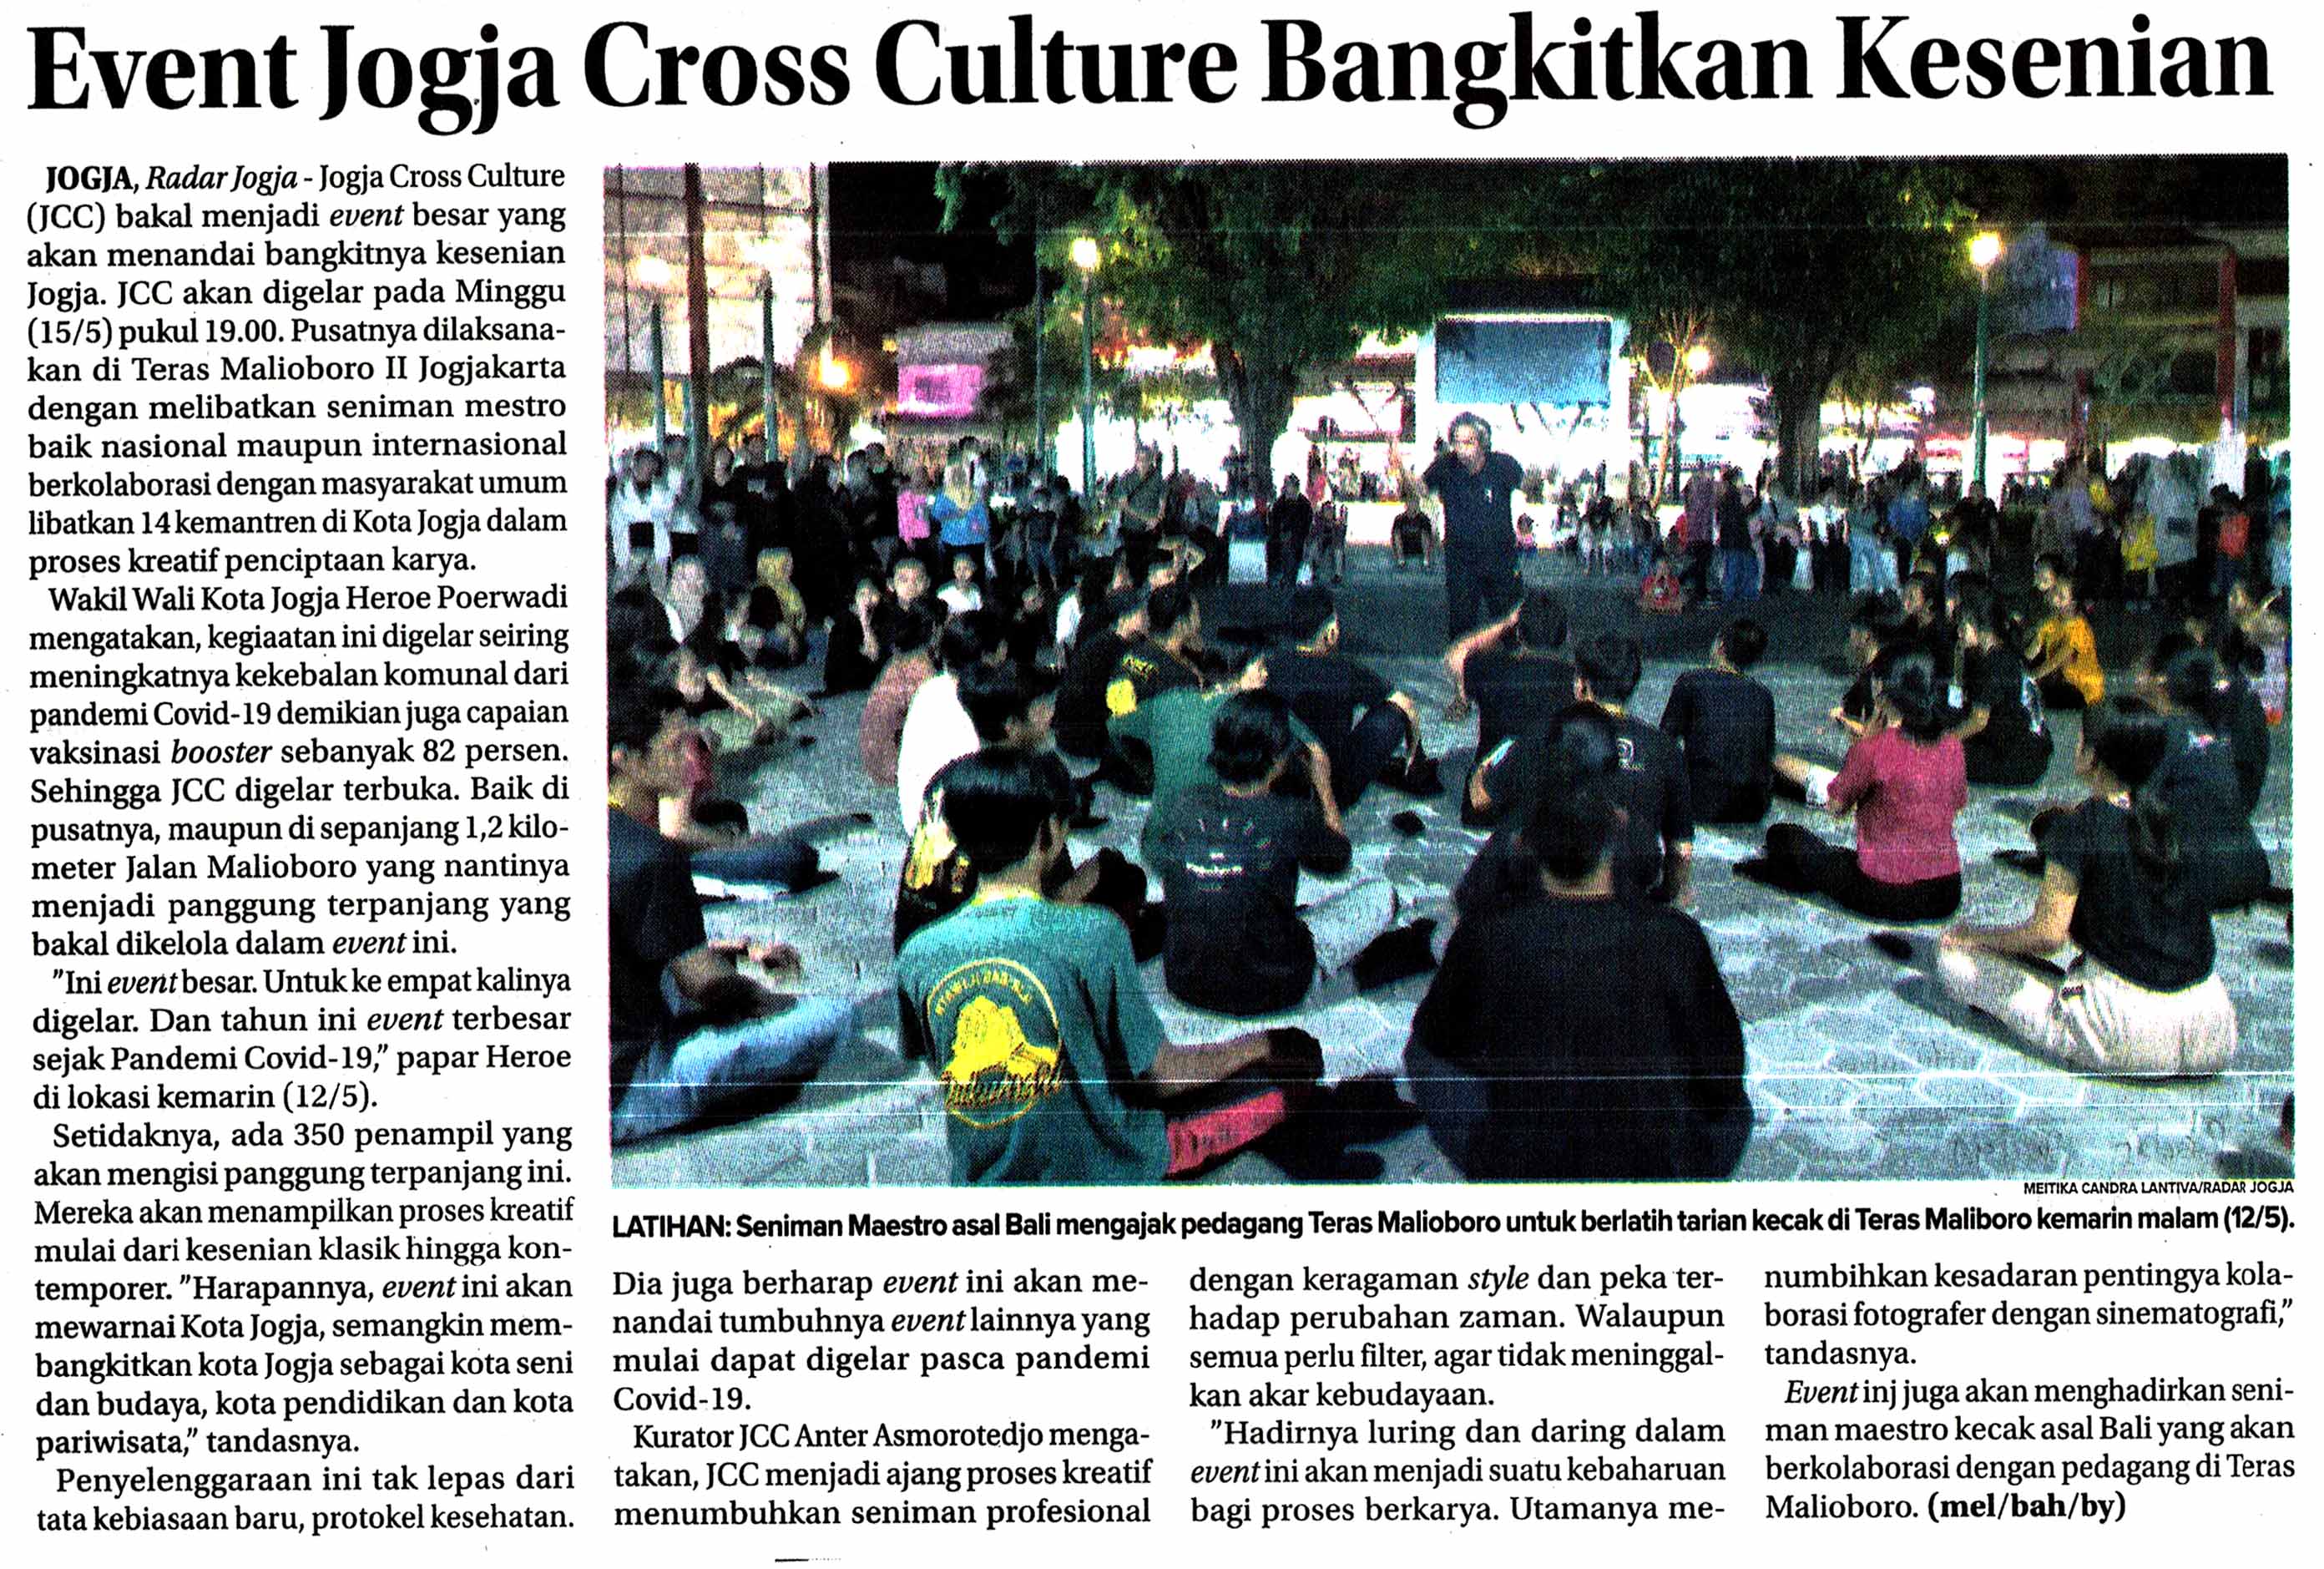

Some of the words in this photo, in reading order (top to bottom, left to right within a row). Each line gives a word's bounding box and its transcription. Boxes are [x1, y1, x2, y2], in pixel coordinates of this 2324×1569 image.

[26, 26, 300, 110] Event
[318, 23, 561, 137] Jogja
[584, 21, 851, 108] Cross
[875, 13, 1238, 106] Culture
[1260, 10, 1814, 130] Bangkitkan
[1836, 13, 2275, 100] Kesenian
[27, 201, 105, 235] (JCC)
[115, 202, 193, 229] bakal
[201, 201, 321, 235] menjadi
[329, 204, 405, 227] event
[412, 200, 490, 227] besar
[497, 207, 567, 233] yang
[27, 281, 107, 313] Jogja.
[117, 280, 173, 309] JCC
[183, 278, 253, 305] akan
[263, 278, 364, 311] digelar
[373, 277, 446, 311] pada
[455, 278, 566, 310] Minggu
[27, 356, 82, 382] kan
[93, 356, 122, 382] di
[131, 357, 210, 382] Teras
[220, 354, 375, 381] Malioboro
[385, 355, 408, 380] II
[418, 353, 567, 387] Jogjakarta
[28, 433, 93, 459] baik
[101, 432, 228, 458] nasional
[236, 438, 363, 464] maupun
[371, 429, 568, 457] internasional
[28, 509, 135, 535] libatkan
[142, 511, 171, 534] 14
[174, 509, 317, 534] kemantren
[322, 508, 348, 534] di
[353, 509, 412, 533] Kota
[417, 508, 482, 540] Jogja
[487, 507, 568, 532] dalam
[28, 624, 201, 658] mengatakan,
[207, 623, 337, 656] kegiaatan
[341, 624, 377, 649] ini
[382, 622, 474, 655] digelar
[479, 622, 569, 655] seiring
[29, 738, 161, 765] vaksinasi
[170, 738, 274, 764] booster
[280, 736, 415, 771] sebanyak
[422, 738, 456, 762] 82
[464, 743, 568, 769] persen.
[31, 819, 161, 849] pusatnya,
[168, 822, 283, 848] maupun
[288, 814, 316, 840] di
[320, 814, 460, 847] sepanjang
[466, 815, 503, 843] 1,2
[508, 812, 569, 838] kilo-
[31, 891, 155, 925] menjadi
[168, 898, 316, 924] panggung
[326, 891, 489, 923] terpanjang
[499, 896, 571, 923] yang
[33, 1007, 139, 1040] digelar.
[149, 1008, 212, 1033] Dan
[220, 1005, 308, 1032] tahun
[317, 1006, 357, 1031] ini
[366, 1008, 445, 1031] event
[452, 1005, 572, 1030] terbesar
[33, 1083, 61, 1110] di
[67, 1083, 150, 1110] lokasi
[157, 1083, 275, 1109] kemarin
[283, 1080, 377, 1114] (12/5).
[33, 1160, 102, 1187] akan
[107, 1161, 219, 1193] mengisi
[224, 1166, 366, 1192] panggung
[370, 1159, 523, 1191] terpanjang
[527, 1158, 572, 1183] ini.
[2023, 1182, 2079, 1195] MEITIKA
[2081, 1182, 2139, 1195] CANDRA
[2141, 1181, 2246, 1195] LANTIVA/RADAR
[2250, 1180, 2295, 1194] JOGJA
[613, 1214, 731, 1238] LATIHAN:
[736, 1212, 843, 1237] Seniman
[848, 1213, 948, 1237] Maestro
[952, 1212, 1000, 1237] asal
[1005, 1212, 1051, 1236] Bali
[1056, 1211, 1177, 1241] mengajak
[1181, 1211, 1303, 1240] pedagang
[1307, 1210, 1373, 1234] Teras
[1377, 1209, 1502, 1233] Malioboro
[1506, 1209, 1577, 1232] untuk
[1581, 1208, 1673, 1232] berlatih
[1676, 1207, 1747, 1232] tarian
[1752, 1207, 1824, 1232] kecak
[1827, 1207, 1850, 1231] di
[1854, 1207, 1921, 1231] Teras
[1925, 1206, 2033, 1231] Maliboro
[2037, 1205, 2133, 1230] kemarin
[2138, 1206, 2219, 1230] malam
[2223, 1204, 2296, 1234] (12/5).
[34, 1237, 117, 1263] mulai
[123, 1236, 180, 1263] dari
[185, 1236, 312, 1262] kesenian
[318, 1235, 402, 1261] klasik
[406, 1235, 502, 1267] hingga
[508, 1234, 573, 1260] kon-
[613, 1271, 664, 1295] Dia
[670, 1271, 734, 1303] juga
[742, 1268, 873, 1302] berharap
[882, 1271, 959, 1294] event
[966, 1268, 1004, 1293] ini
[1013, 1267, 1083, 1293] akan
[1092, 1274, 1149, 1293] me-
[1190, 1266, 1295, 1299] dengan
[1302, 1265, 1459, 1298] keragaman
[1468, 1264, 1530, 1298] style
[1538, 1264, 1591, 1290] dan
[1599, 1263, 1668, 1297] peka
[1675, 1268, 1724, 1289] ter-
[34, 1313, 176, 1339] mewarnai
[180, 1313, 245, 1339] Kota
[250, 1313, 326, 1345] Jogja,
[332, 1311, 485, 1344] semangkin
[489, 1318, 573, 1337] mem-
[1189, 1304, 1280, 1337] hadap
[1290, 1303, 1450, 1337] perubahan
[1459, 1309, 1565, 1329] zaman.
[1575, 1302, 1725, 1335] Walaupun
[613, 1346, 700, 1373] mulai
[710, 1346, 796, 1379] dapat
[806, 1345, 910, 1379] digelar
[920, 1351, 1005, 1378] pasca
[1015, 1344, 1150, 1377] pandemi
[36, 1390, 90, 1417] dan
[96, 1389, 208, 1423] budaya,
[215, 1389, 277, 1415] kota
[283, 1389, 446, 1422] pendidikan
[452, 1388, 507, 1414] dan
[513, 1388, 574, 1414] kota
[1784, 1379, 1860, 1404] Event
[1902, 1379, 1960, 1410] juga
[1965, 1377, 2029, 1403] akan
[2034, 1376, 2226, 1410] menghadirkan
[2231, 1383, 2294, 1402] seni-
[56, 1465, 312, 1500] Penyelenggaraan
[322, 1465, 362, 1491] ini
[371, 1464, 419, 1491] tak
[427, 1464, 505, 1497] lepas
[516, 1463, 575, 1490] dari
[1765, 1454, 1951, 1480] berkolaborasi
[1956, 1453, 2056, 1486] dengan
[2061, 1452, 2190, 1486] pedagang
[2195, 1452, 2222, 1478] di
[2225, 1453, 2296, 1478] Teras
[1766, 1493, 1918, 1519] Malioboro.
[1927, 1490, 2126, 1525] (mel/bah/by)
